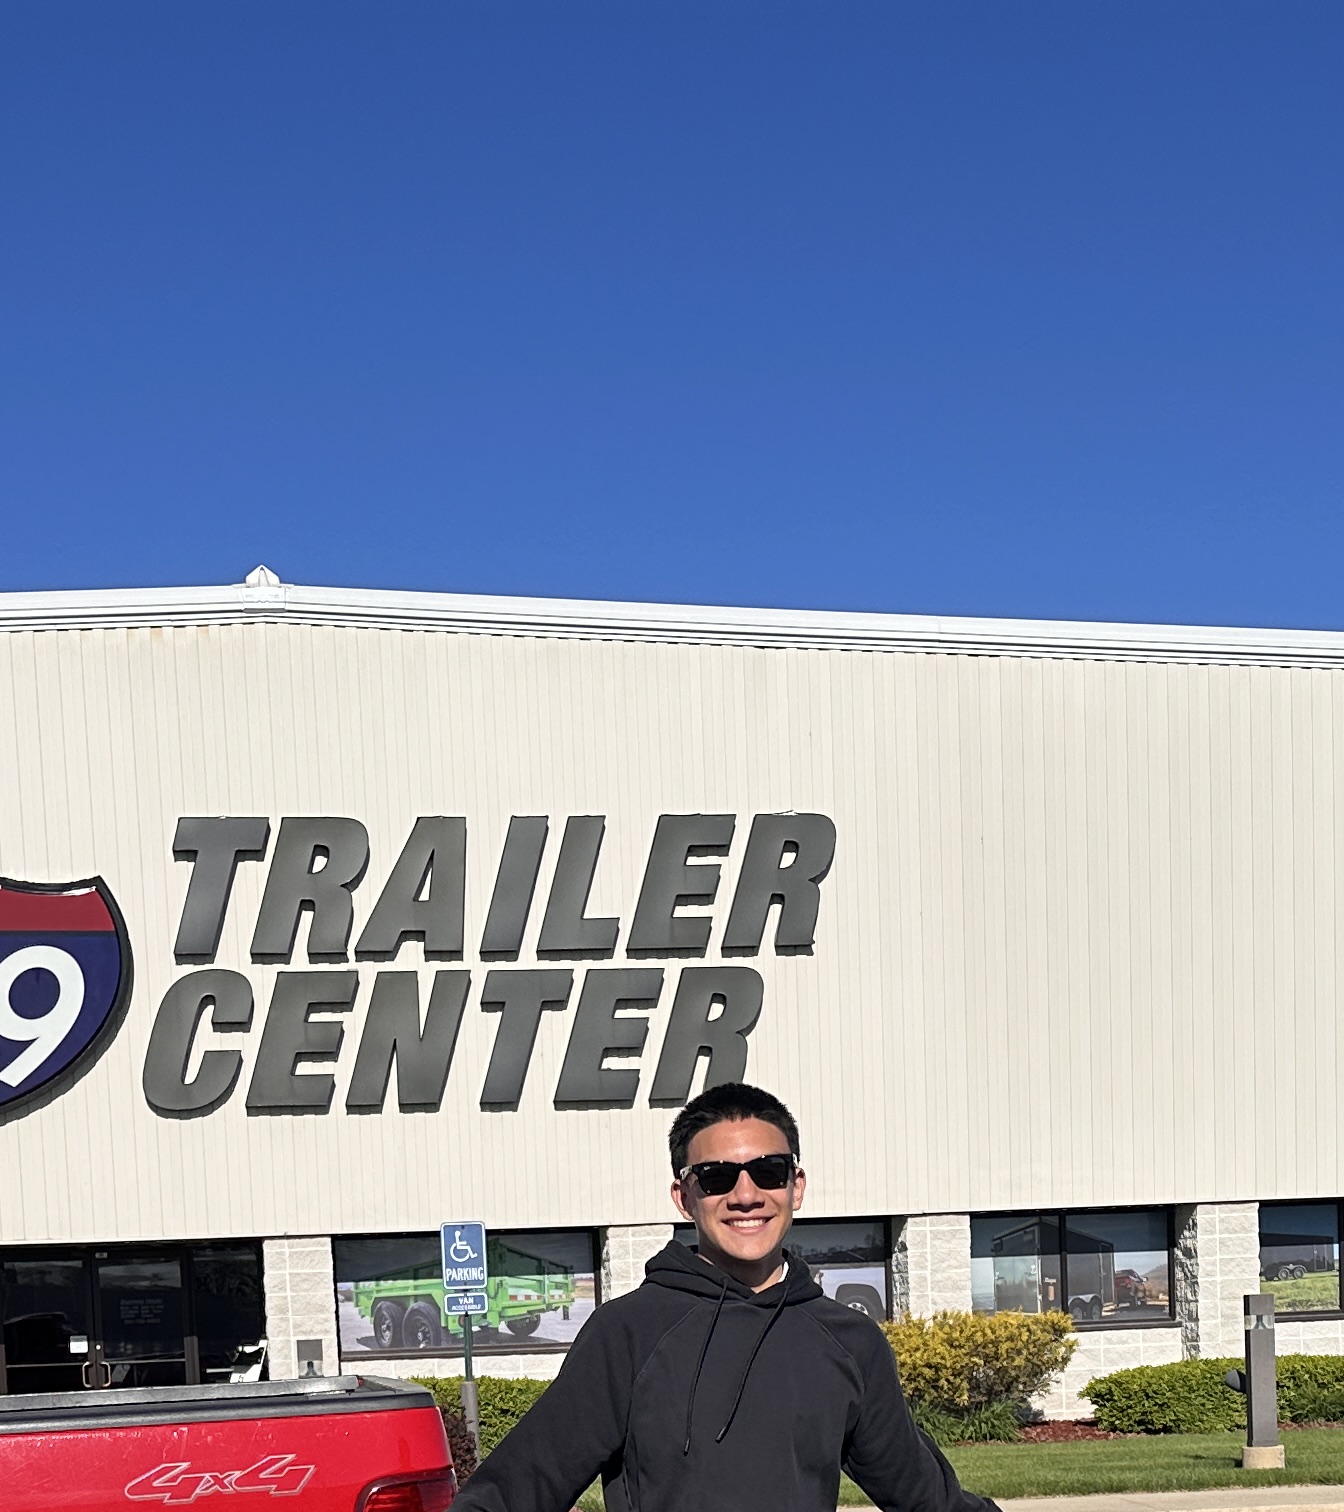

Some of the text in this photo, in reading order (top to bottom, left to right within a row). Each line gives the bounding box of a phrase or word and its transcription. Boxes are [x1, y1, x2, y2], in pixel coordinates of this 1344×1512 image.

[173, 812, 837, 965] TRAILER
[142, 965, 766, 1117] CENTER
[445, 1266, 484, 1281] PARKING
[124, 1453, 316, 1506] 4x4
